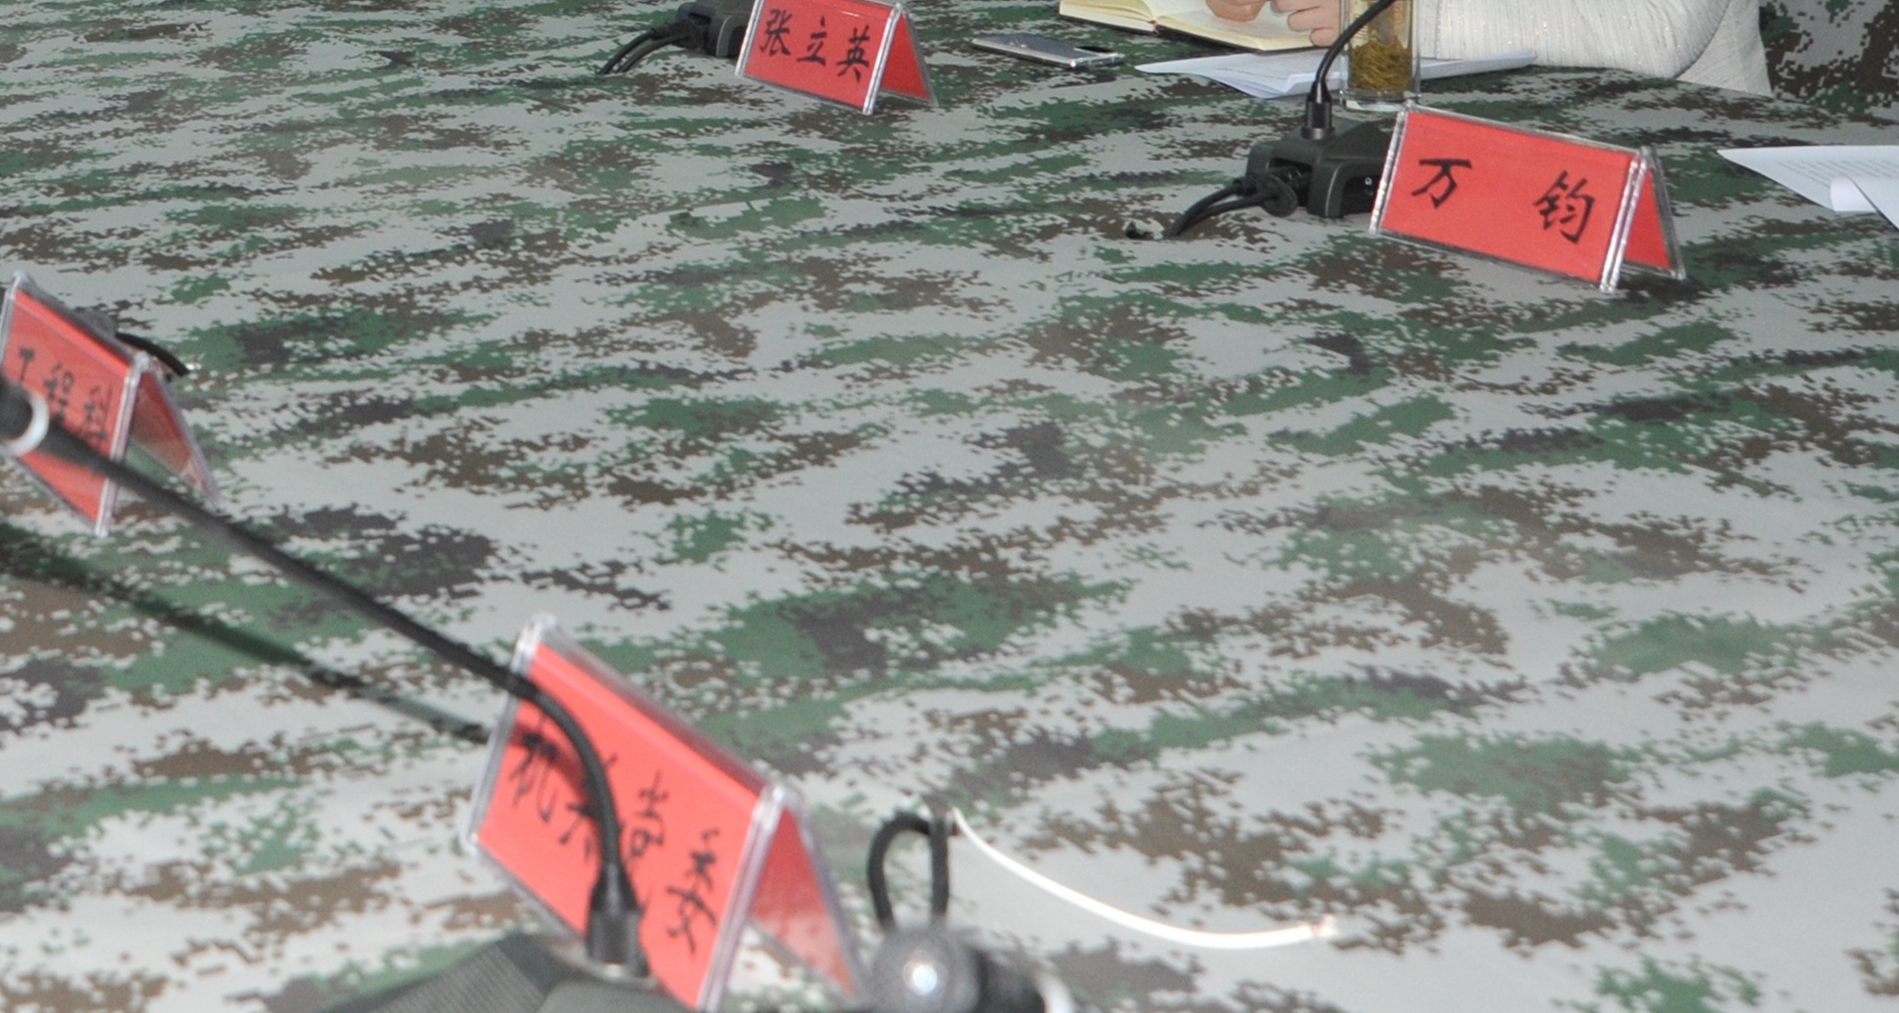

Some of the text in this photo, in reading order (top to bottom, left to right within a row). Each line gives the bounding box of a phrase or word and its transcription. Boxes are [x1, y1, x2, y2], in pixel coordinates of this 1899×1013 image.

[758, 8, 870, 83] 张立英
[1410, 158, 1596, 246] 万钧
